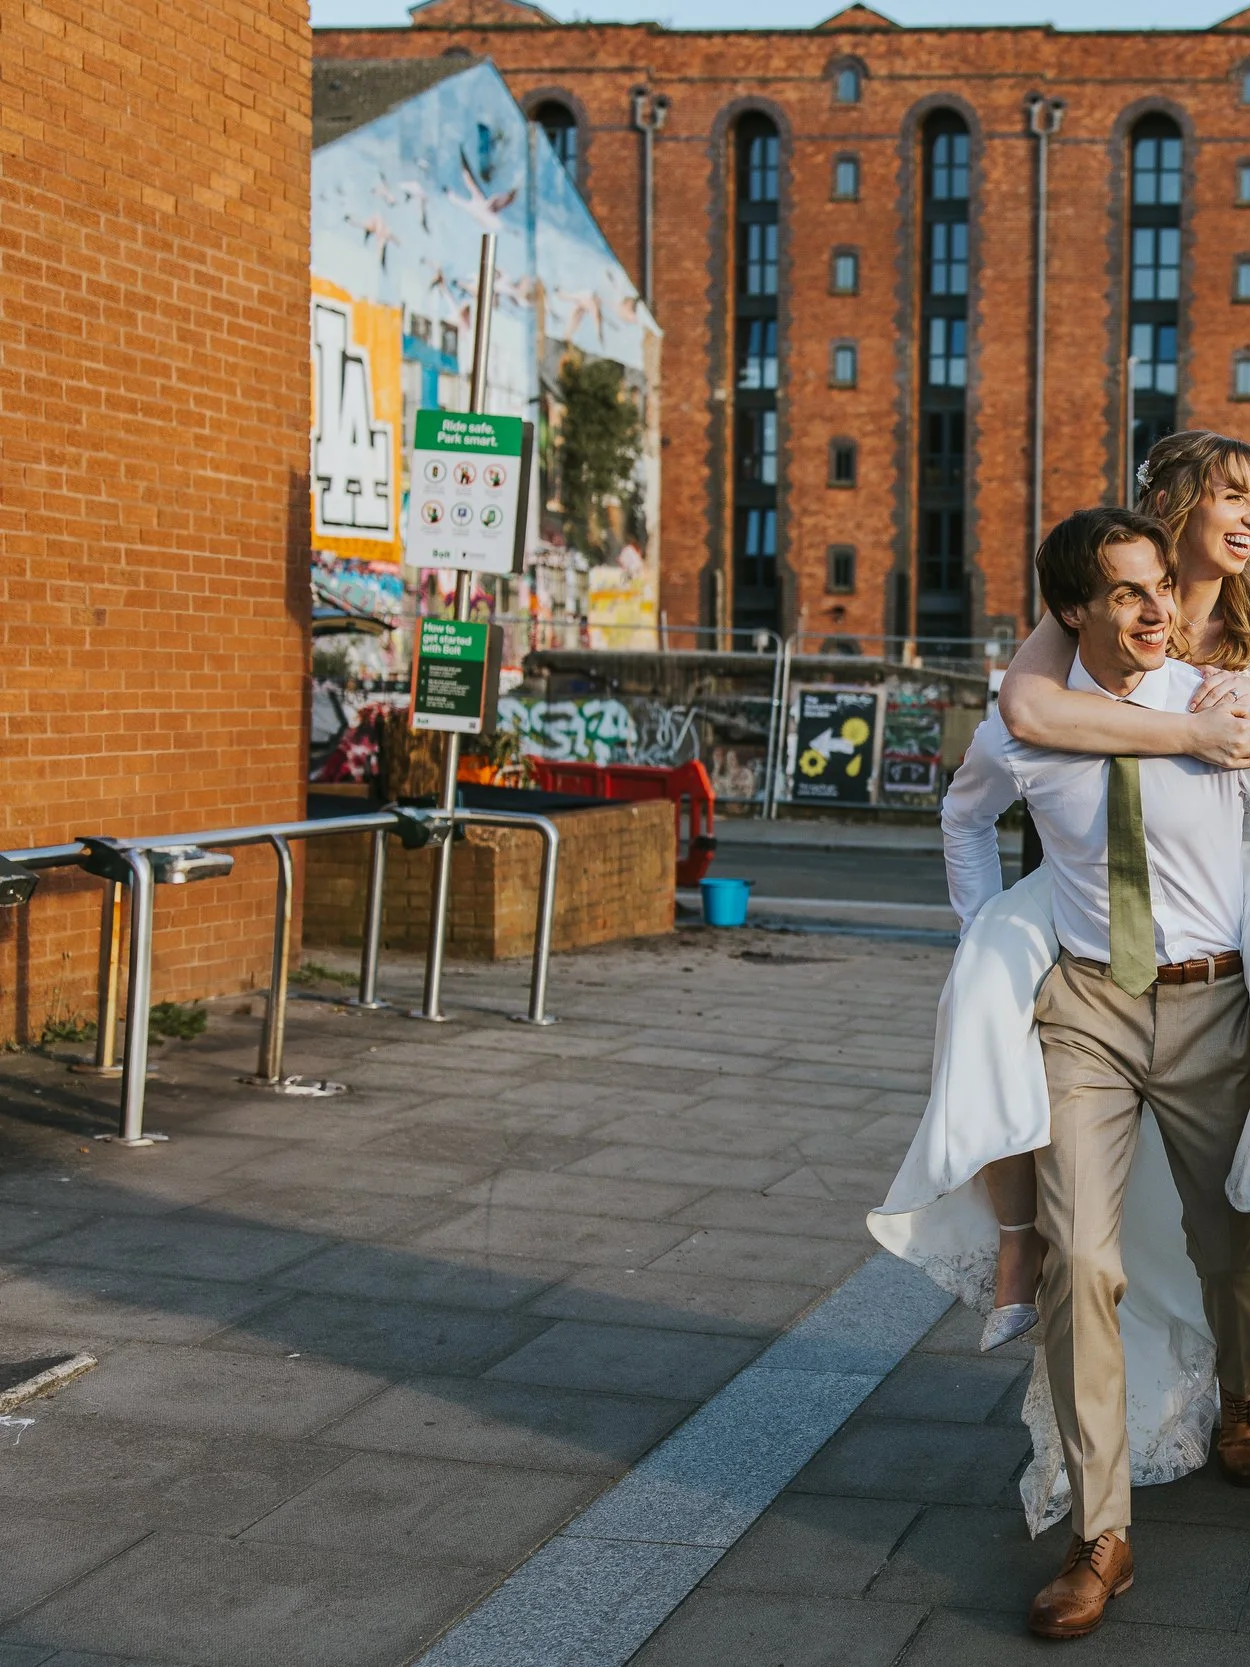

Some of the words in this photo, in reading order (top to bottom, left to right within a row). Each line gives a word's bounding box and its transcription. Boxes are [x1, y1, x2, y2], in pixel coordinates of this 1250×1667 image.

[442, 419, 467, 432] Ride
[468, 422, 494, 435] safe.
[437, 431, 462, 444] Park
[464, 434, 499, 448] smart.
[423, 622, 444, 633] How
[445, 624, 456, 634] to
[422, 634, 438, 645] get
[439, 635, 472, 646] started
[422, 644, 441, 654] with
[442, 645, 461, 656] Bolt
